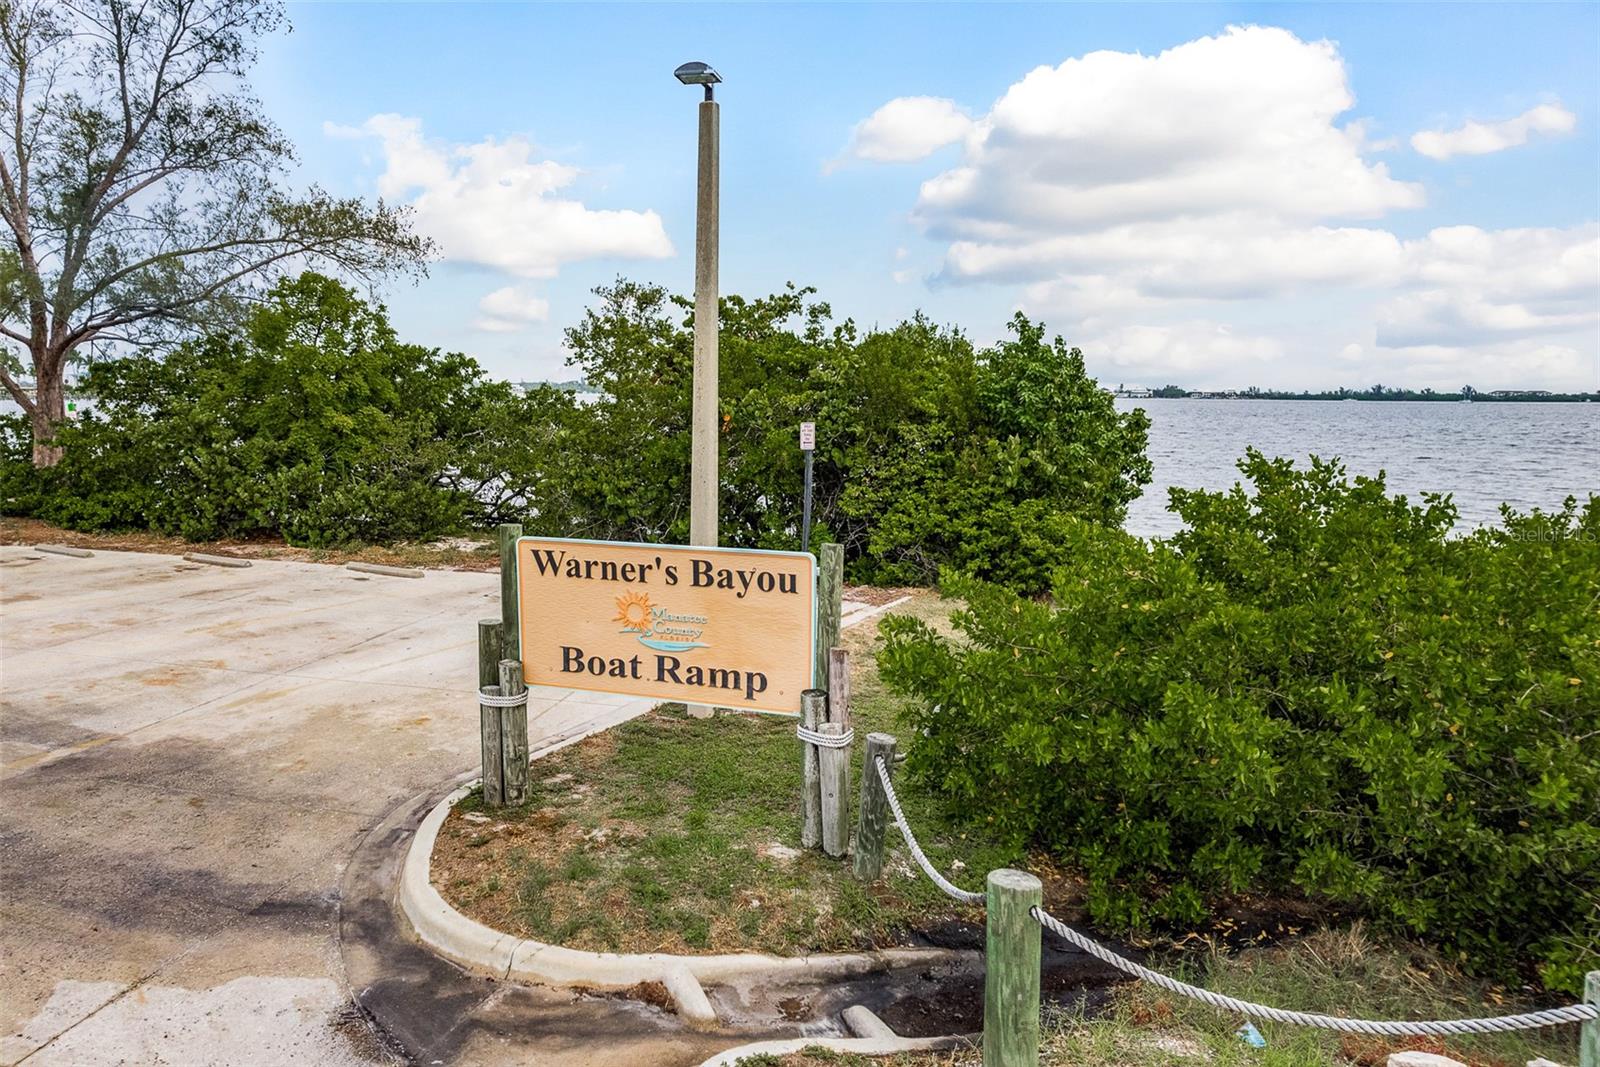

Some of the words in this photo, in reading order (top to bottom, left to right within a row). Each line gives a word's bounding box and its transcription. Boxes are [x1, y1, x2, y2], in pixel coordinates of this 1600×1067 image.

[530, 549, 679, 586] Warner's
[690, 559, 799, 598] Bayou
[651, 607, 708, 624] Manatee
[653, 621, 704, 638] County
[560, 645, 643, 680] Boat
[654, 654, 768, 700] Ramp
